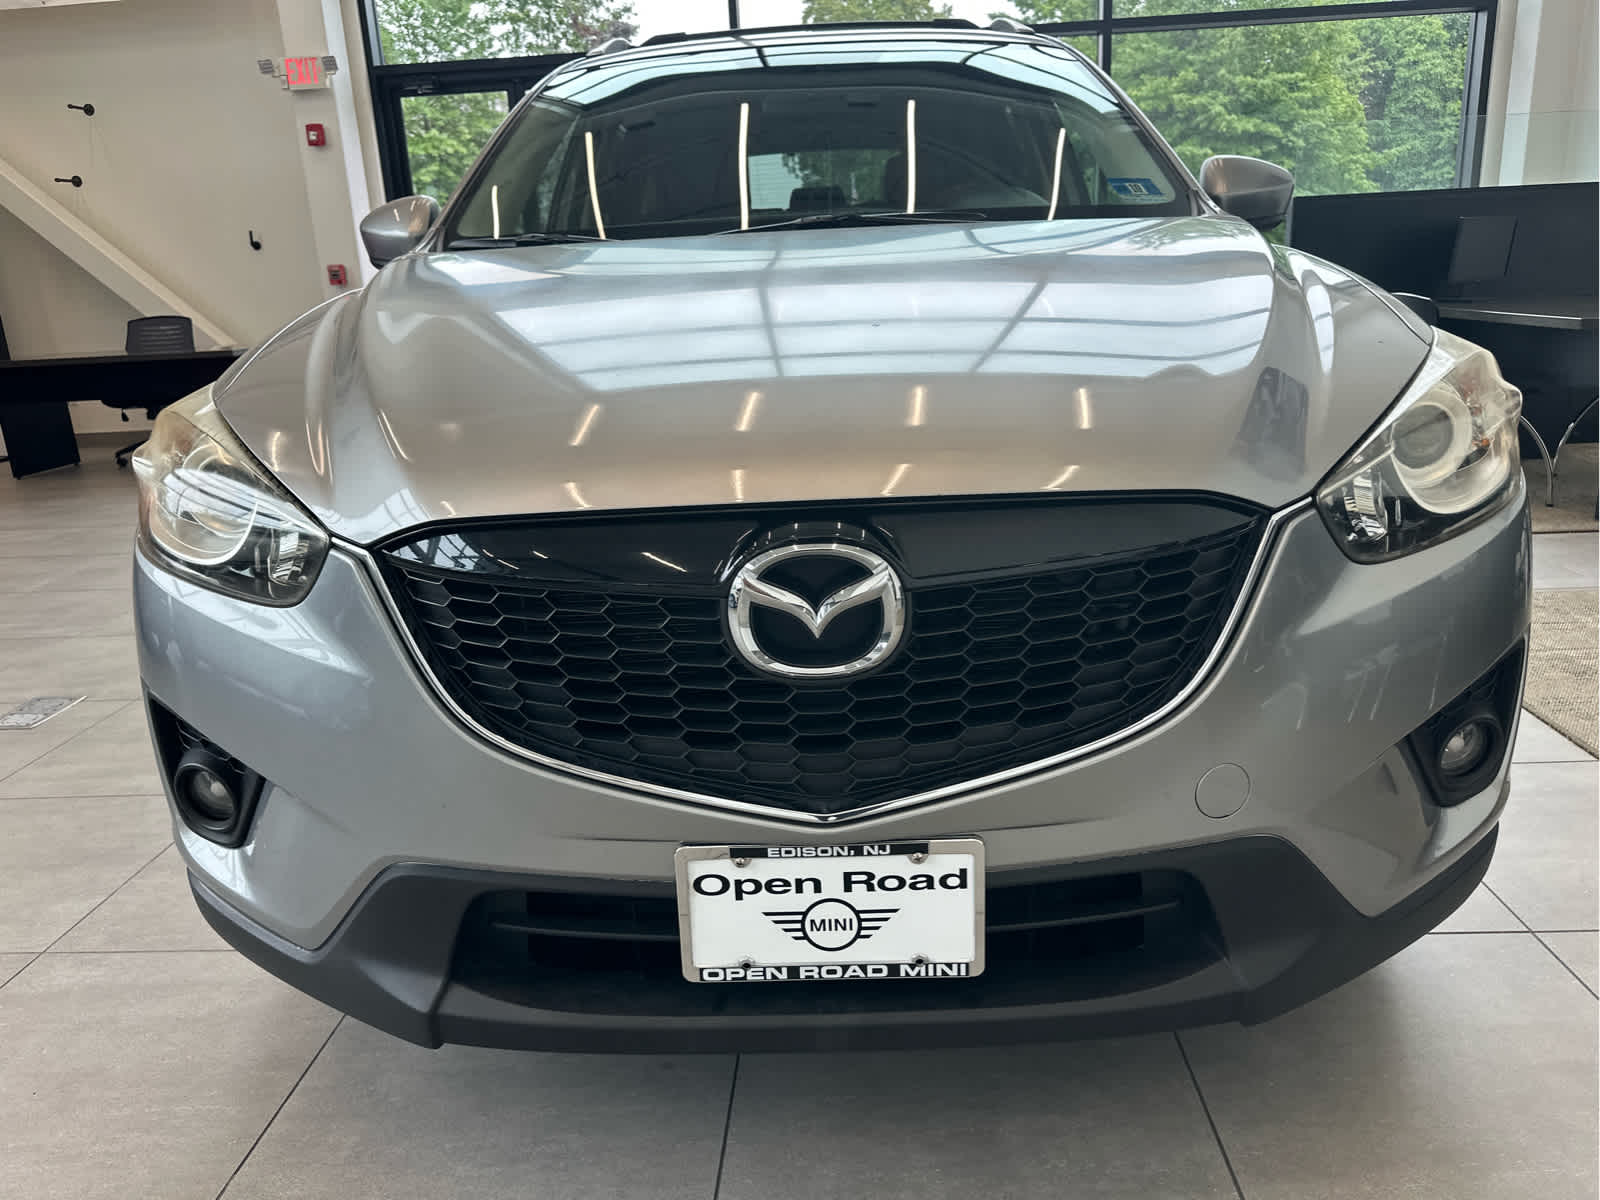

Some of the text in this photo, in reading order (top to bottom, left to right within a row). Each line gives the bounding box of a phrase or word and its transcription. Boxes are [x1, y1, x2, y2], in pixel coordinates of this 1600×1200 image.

[284, 57, 319, 85] EXIT
[767, 844, 890, 858] EDISON, NJ
[693, 868, 968, 901] Open Road
[809, 918, 854, 932] MINI
[702, 962, 968, 981] OPEN ROAD MINI
